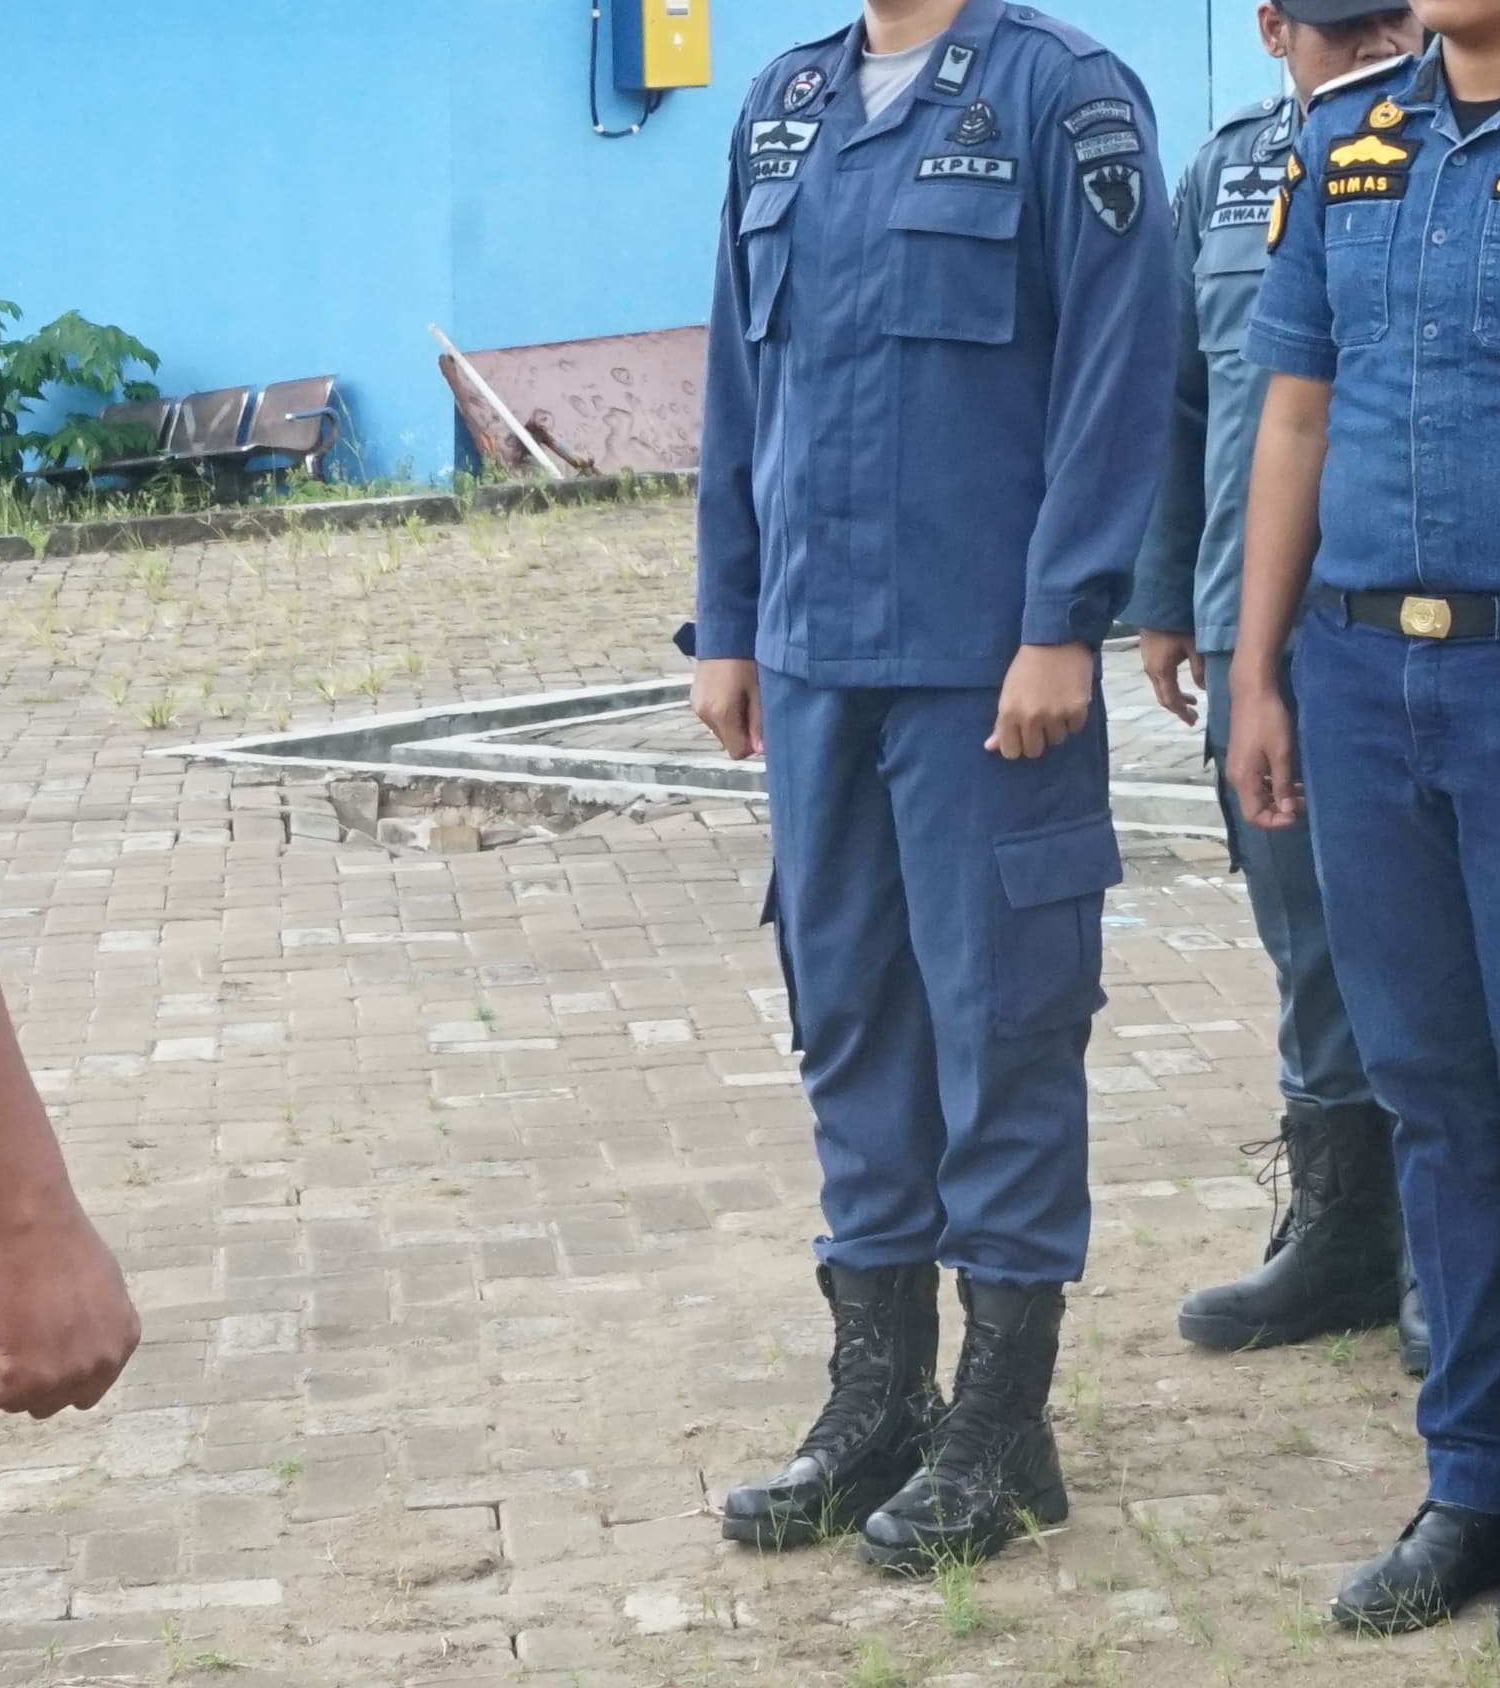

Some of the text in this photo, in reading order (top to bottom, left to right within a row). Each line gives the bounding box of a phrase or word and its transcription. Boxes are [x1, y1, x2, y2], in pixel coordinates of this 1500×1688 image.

[931, 159, 1001, 175] KPLP
[1328, 176, 1387, 195] DIMAS
[1217, 206, 1269, 223] IRWAN
